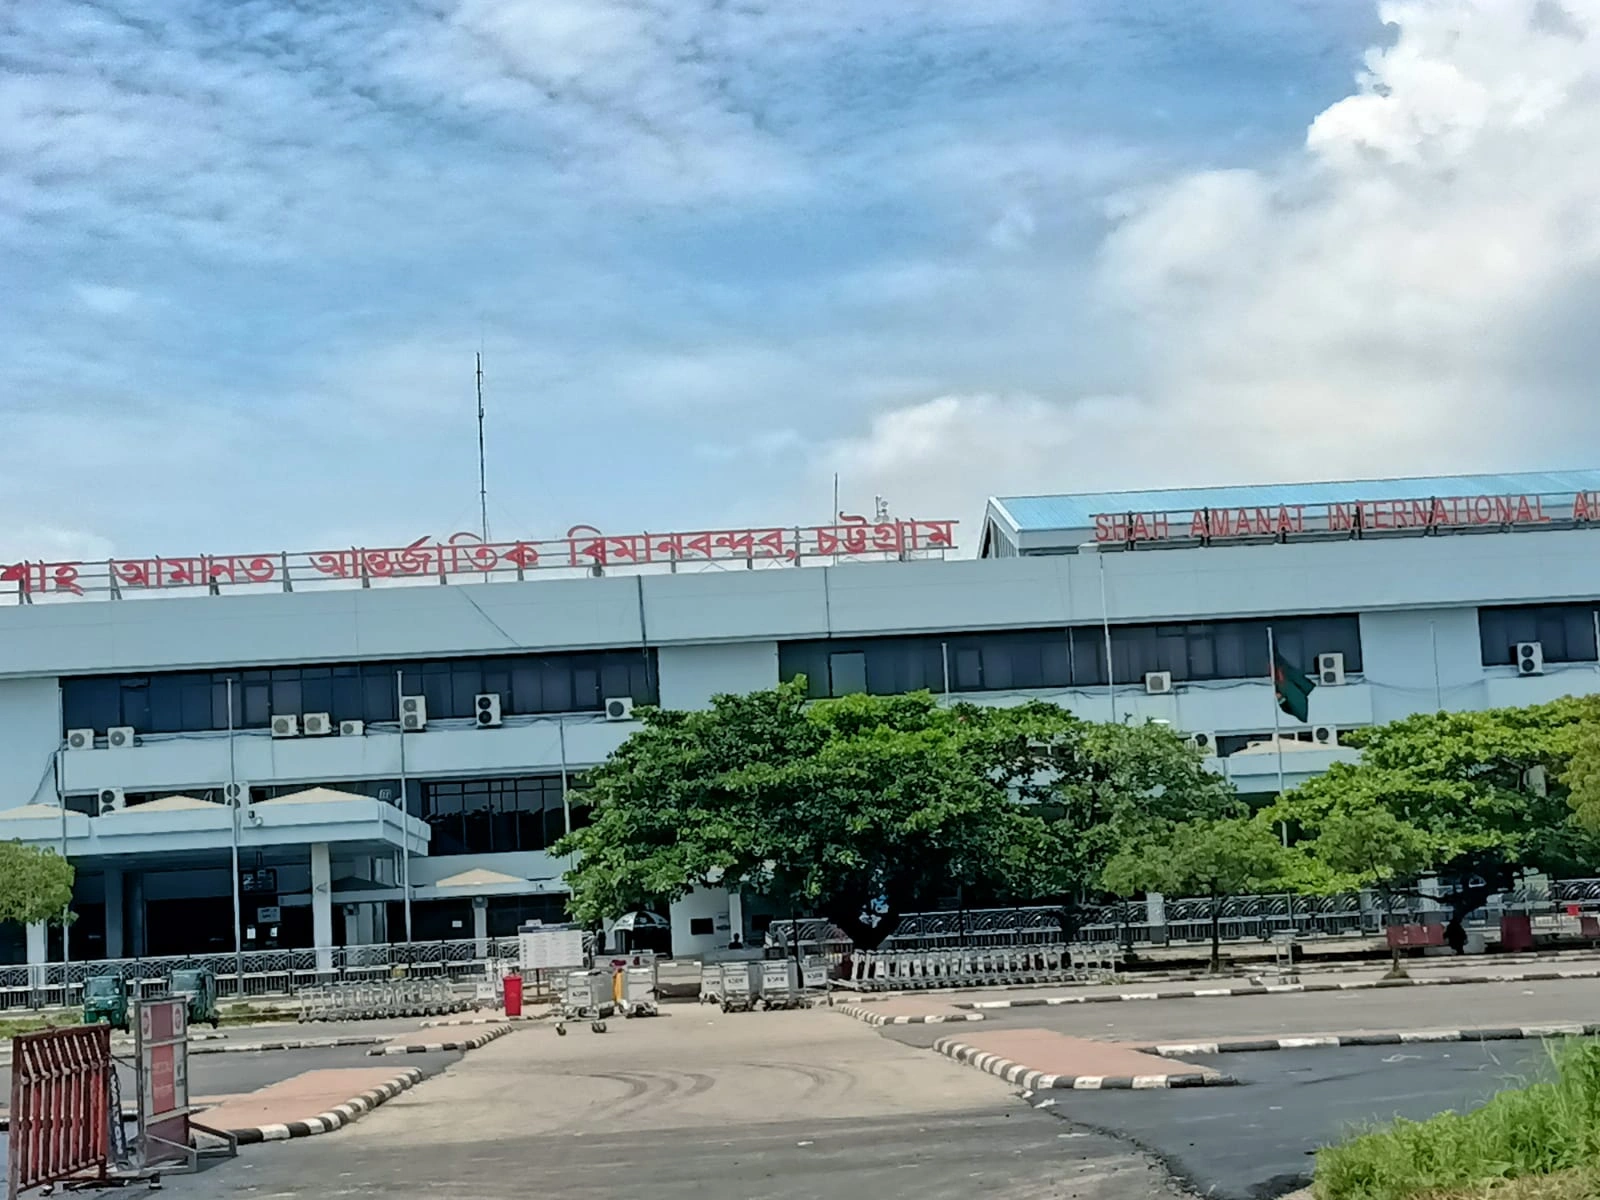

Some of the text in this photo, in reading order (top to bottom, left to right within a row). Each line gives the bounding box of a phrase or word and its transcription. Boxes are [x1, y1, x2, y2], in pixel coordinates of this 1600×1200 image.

[1094, 512, 1169, 542] SHAH
[1190, 503, 1306, 538] AMANAT
[1327, 494, 1552, 532] INTERNATIONAL
[110, 553, 278, 588] আমানত
[307, 532, 541, 579] আন্তর্জাতিক
[809, 511, 959, 554] চট্টগ্রাম
